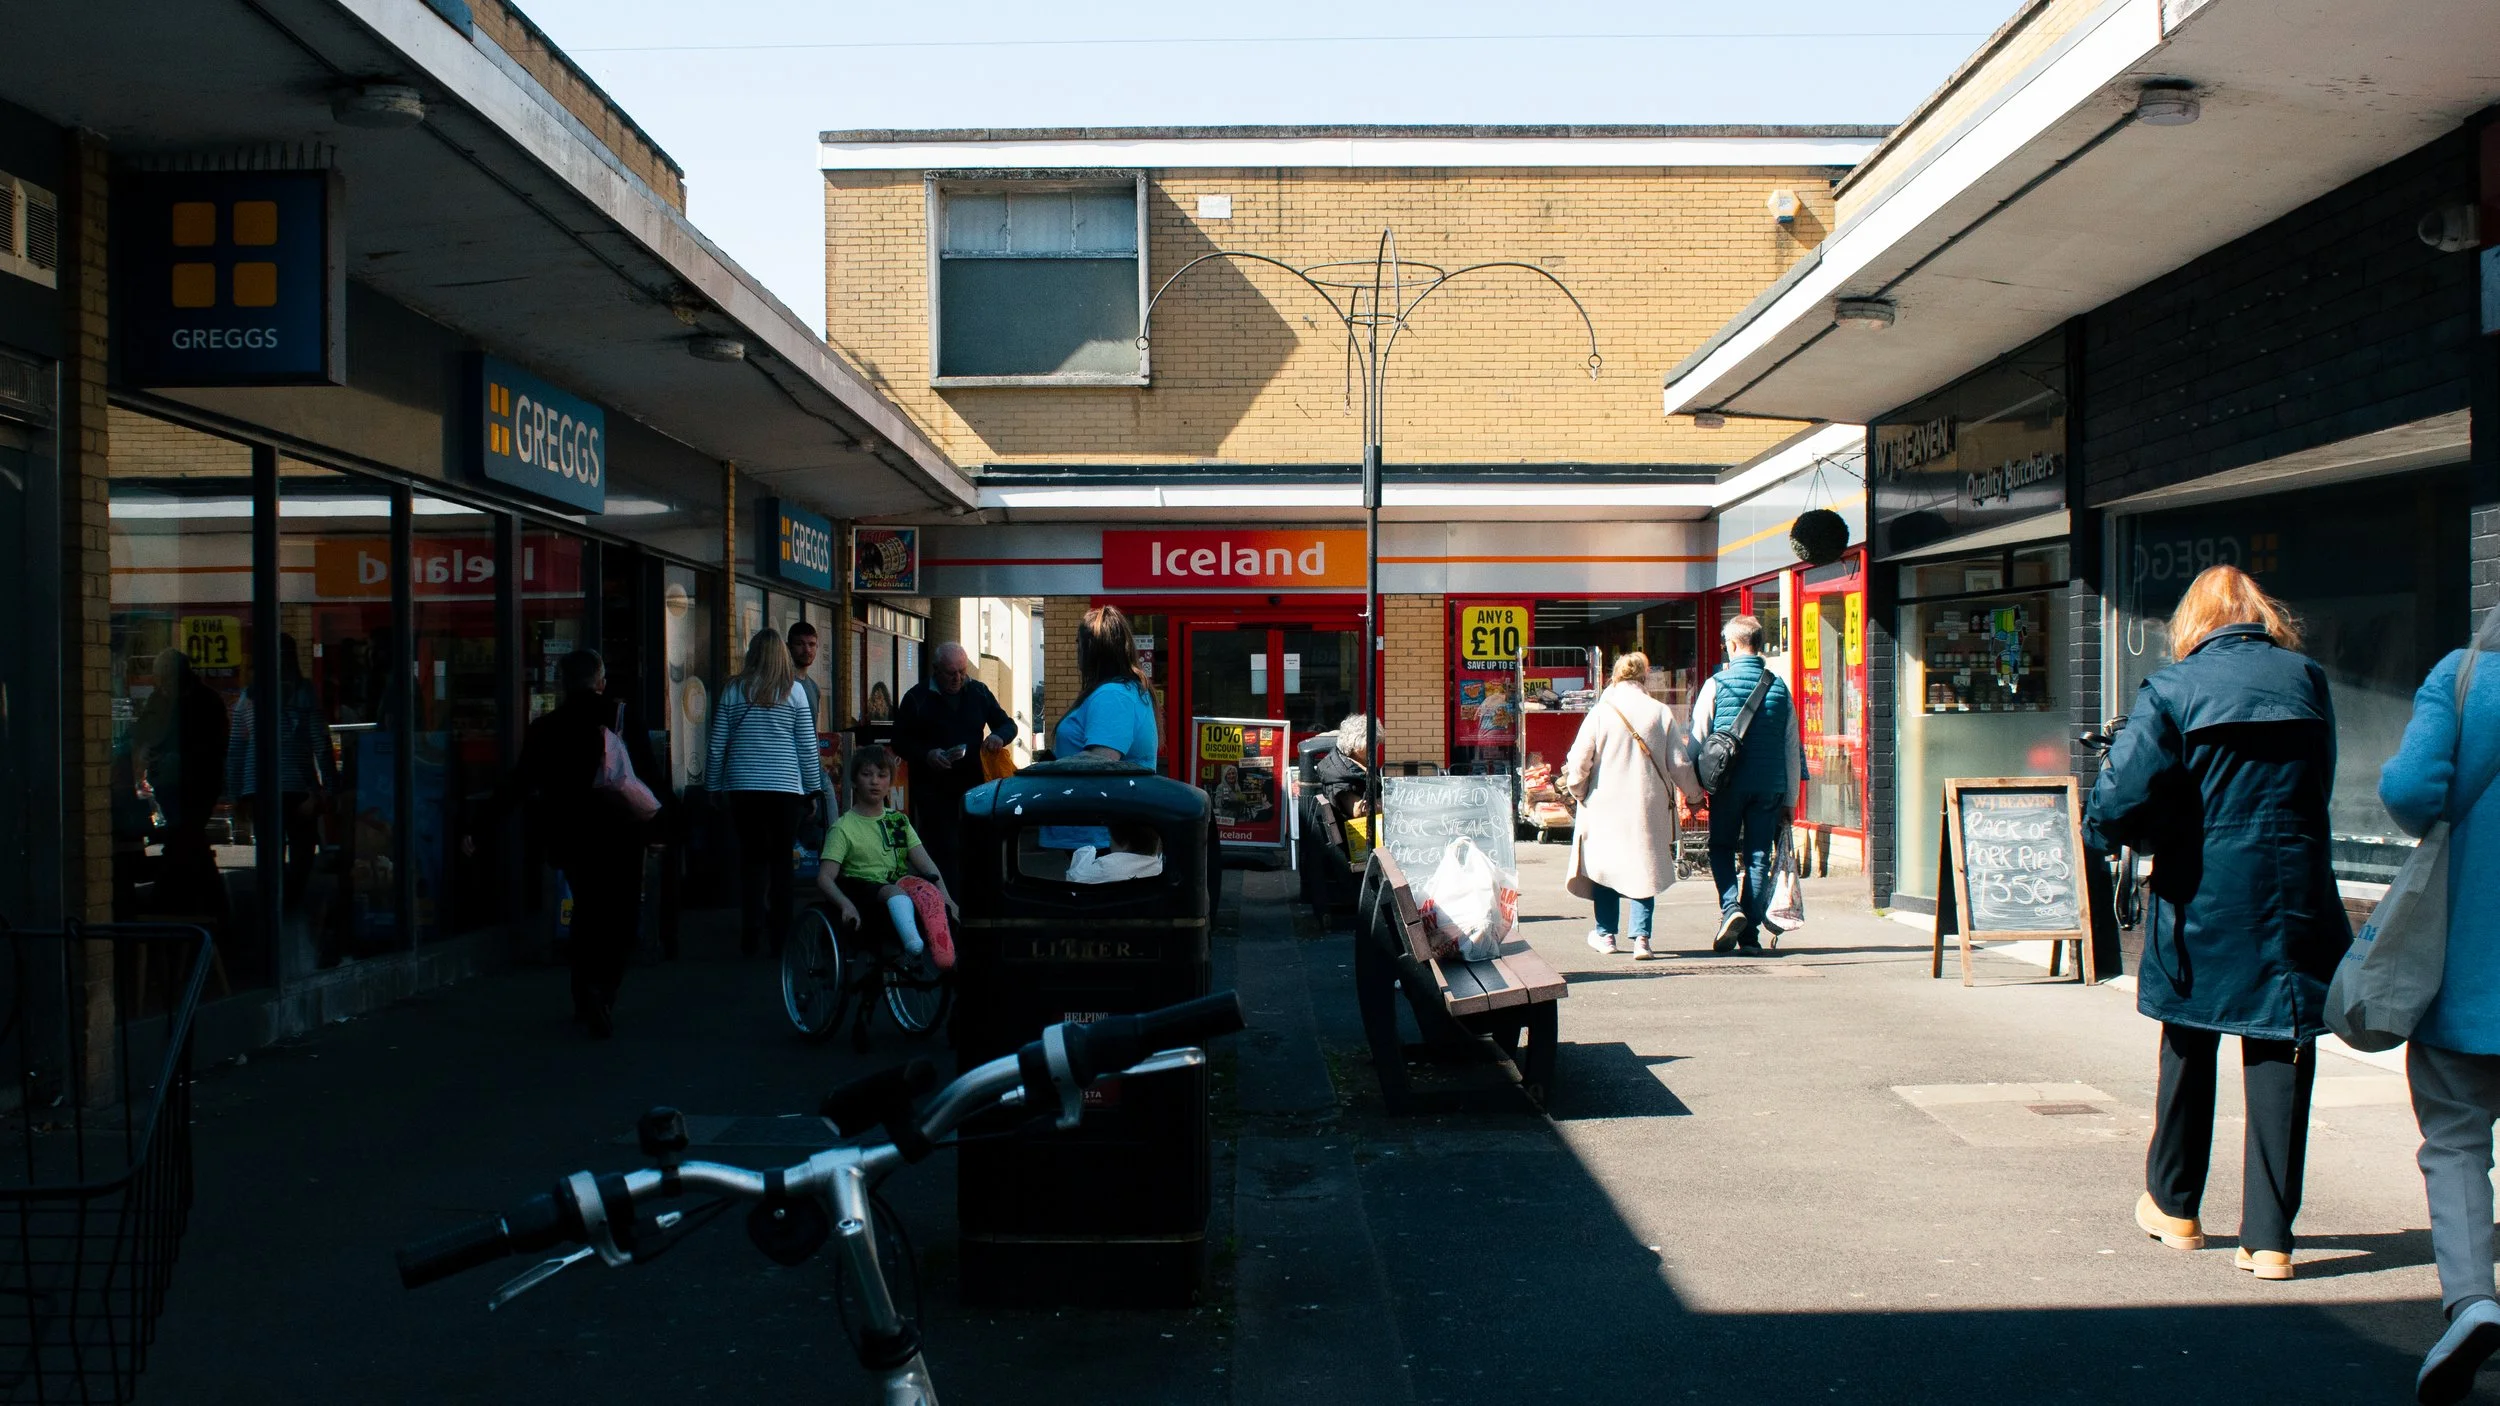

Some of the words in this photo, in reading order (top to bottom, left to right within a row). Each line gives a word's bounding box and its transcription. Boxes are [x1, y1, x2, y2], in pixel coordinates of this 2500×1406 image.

[171, 327, 279, 350] GREGGS
[515, 394, 600, 488] GREGGS
[1966, 472, 2004, 502] Quality
[2005, 451, 2054, 490] Butchers
[791, 520, 829, 574] GREGGS
[1151, 541, 1325, 576] Iceland
[1477, 610, 1504, 624] ANY
[1505, 610, 1514, 624] 8
[1470, 626, 1520, 656] £10
[1467, 660, 1486, 670] SAVE
[1486, 660, 1497, 670] UP
[1498, 660, 1508, 670] TO
[1205, 726, 1241, 744] 10%
[1205, 743, 1242, 754] DISCOUNT
[1390, 783, 1489, 808] MARINATED
[1999, 795, 2056, 809] BEAVEN
[1219, 830, 1253, 841] Iceland
[1389, 810, 1435, 838] PORK
[1438, 814, 1506, 839] STEAKS
[1967, 812, 2022, 840] RACK
[2028, 820, 2057, 839] OF
[1967, 840, 2014, 869] PORK
[2018, 845, 2069, 880] RIBS
